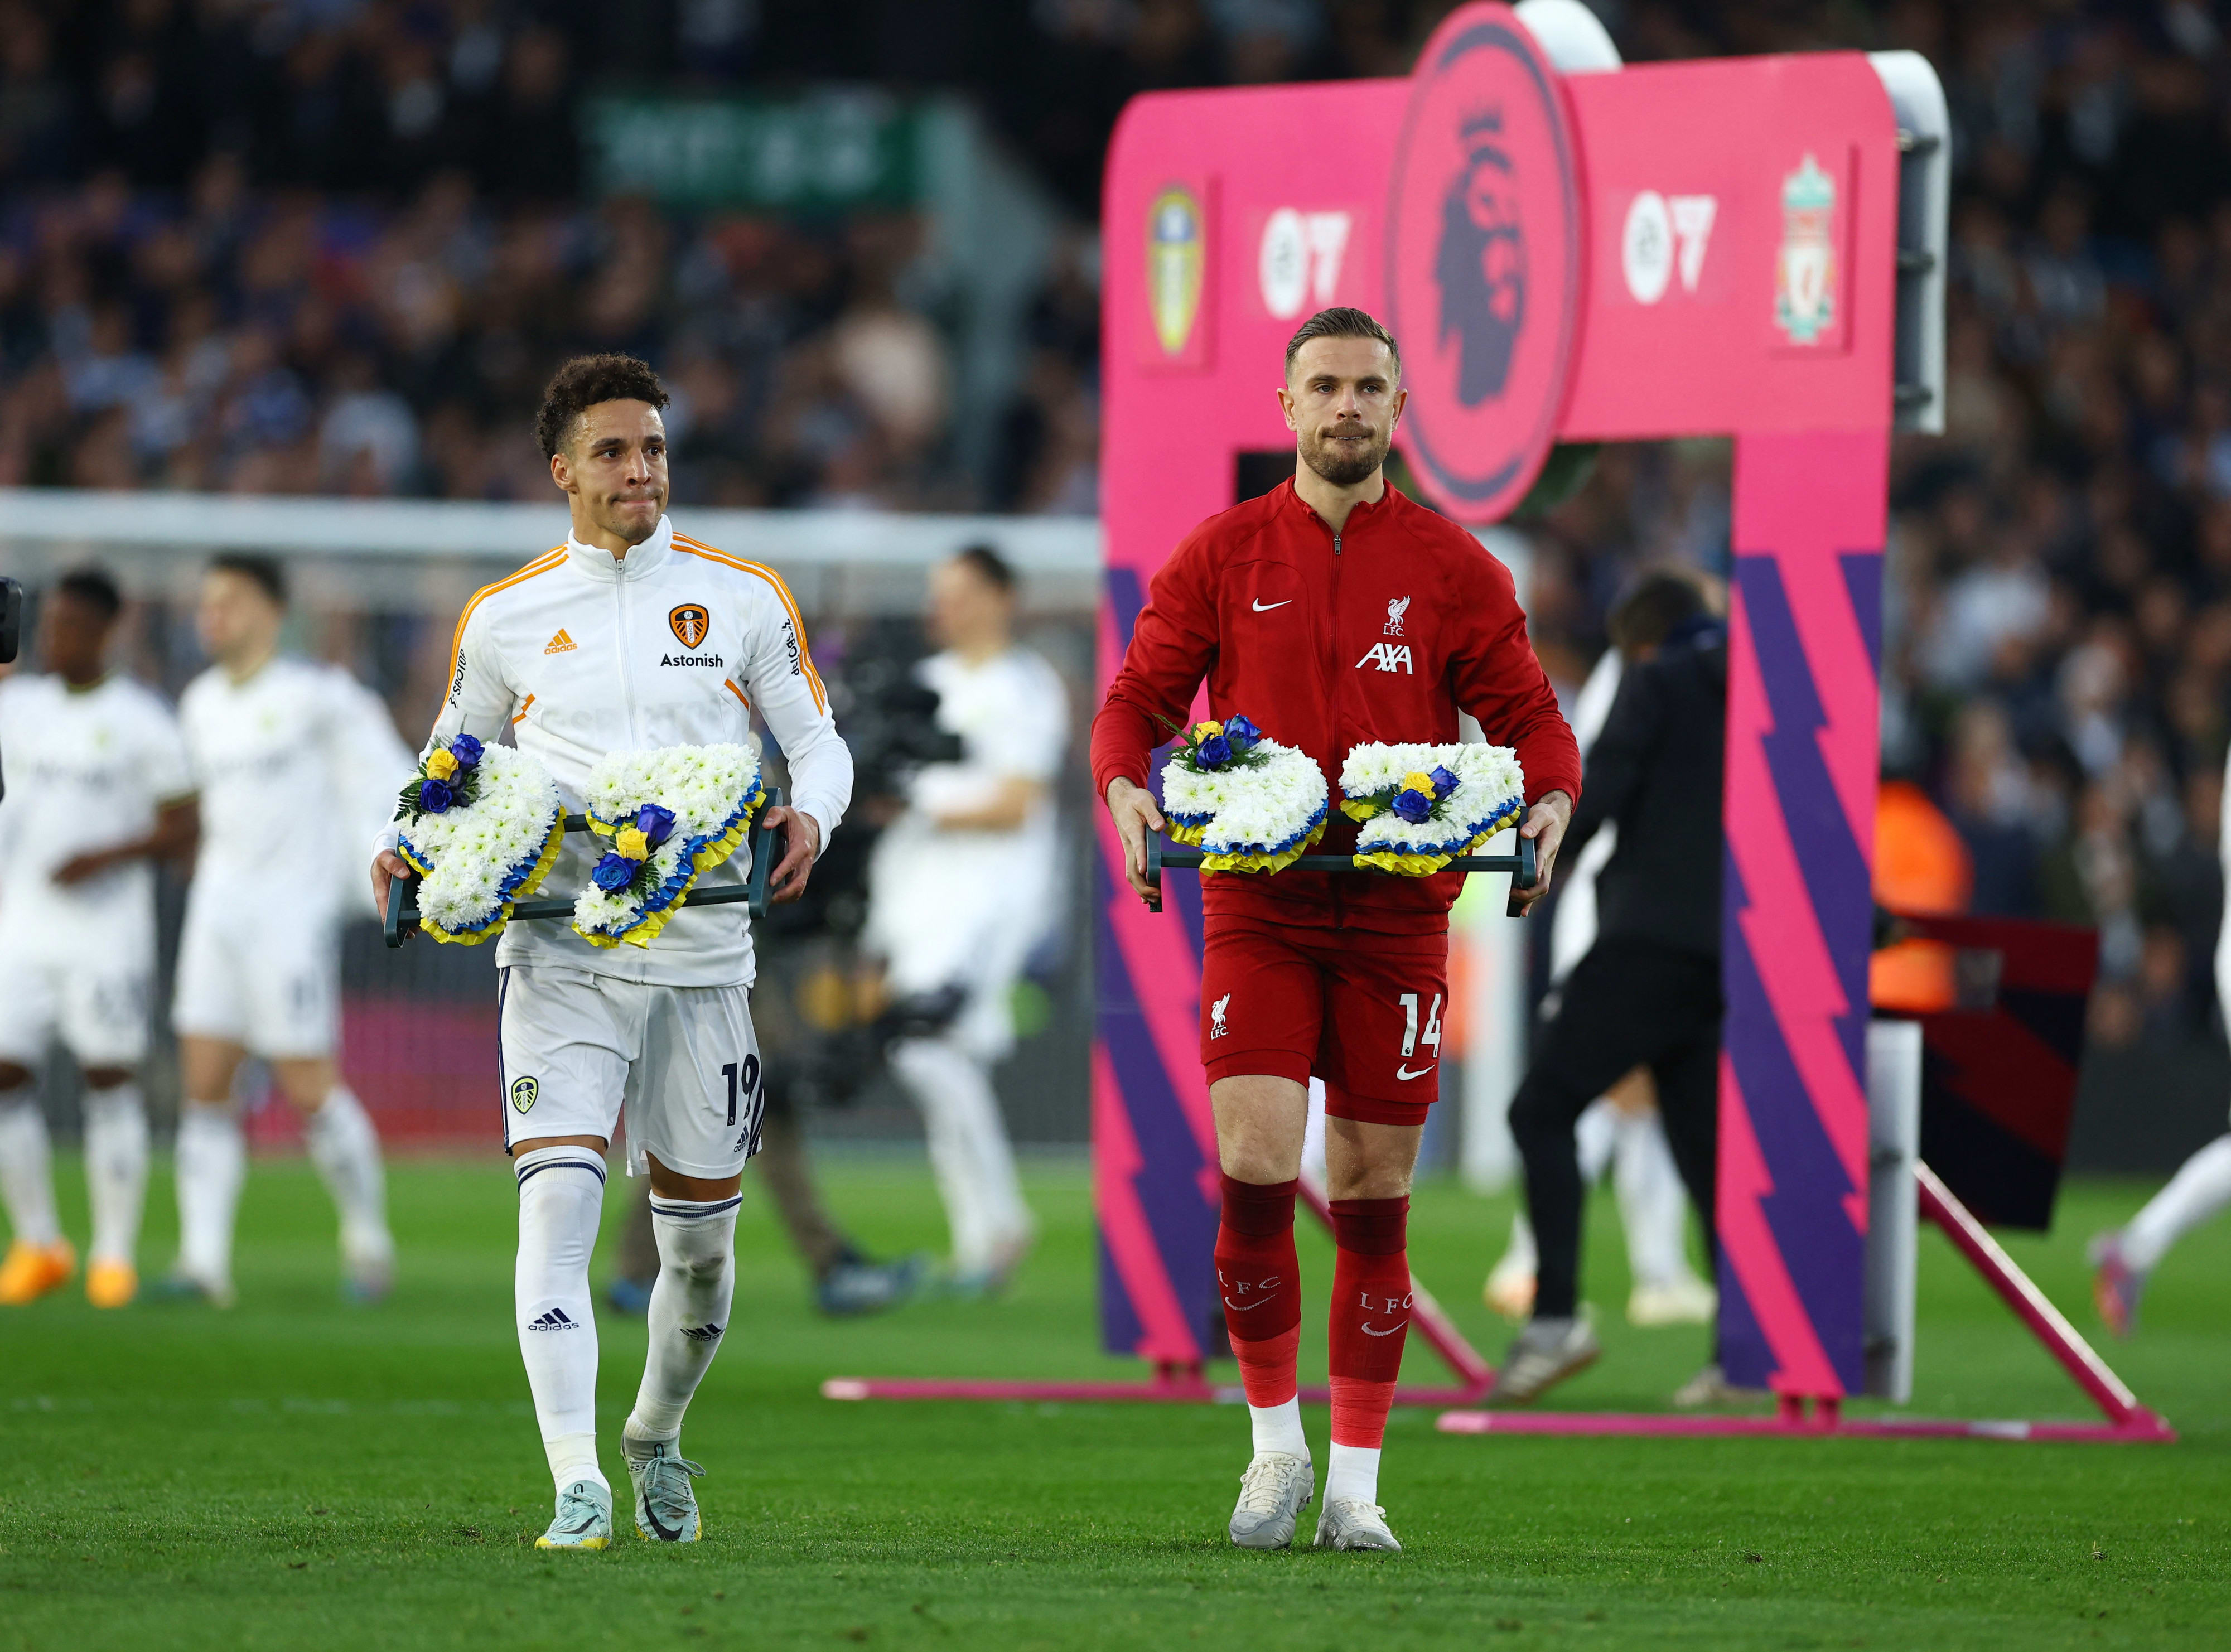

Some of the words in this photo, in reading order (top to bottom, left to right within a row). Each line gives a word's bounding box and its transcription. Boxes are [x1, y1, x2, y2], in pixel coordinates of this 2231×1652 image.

[544, 643, 578, 655] adidas
[660, 653, 723, 668] Astonish
[1355, 642, 1413, 675] AXA
[452, 649, 466, 695] SBOTOP
[1399, 993, 1441, 1058] 14
[721, 1054, 760, 1127] 19
[528, 1322, 580, 1331] adidas
